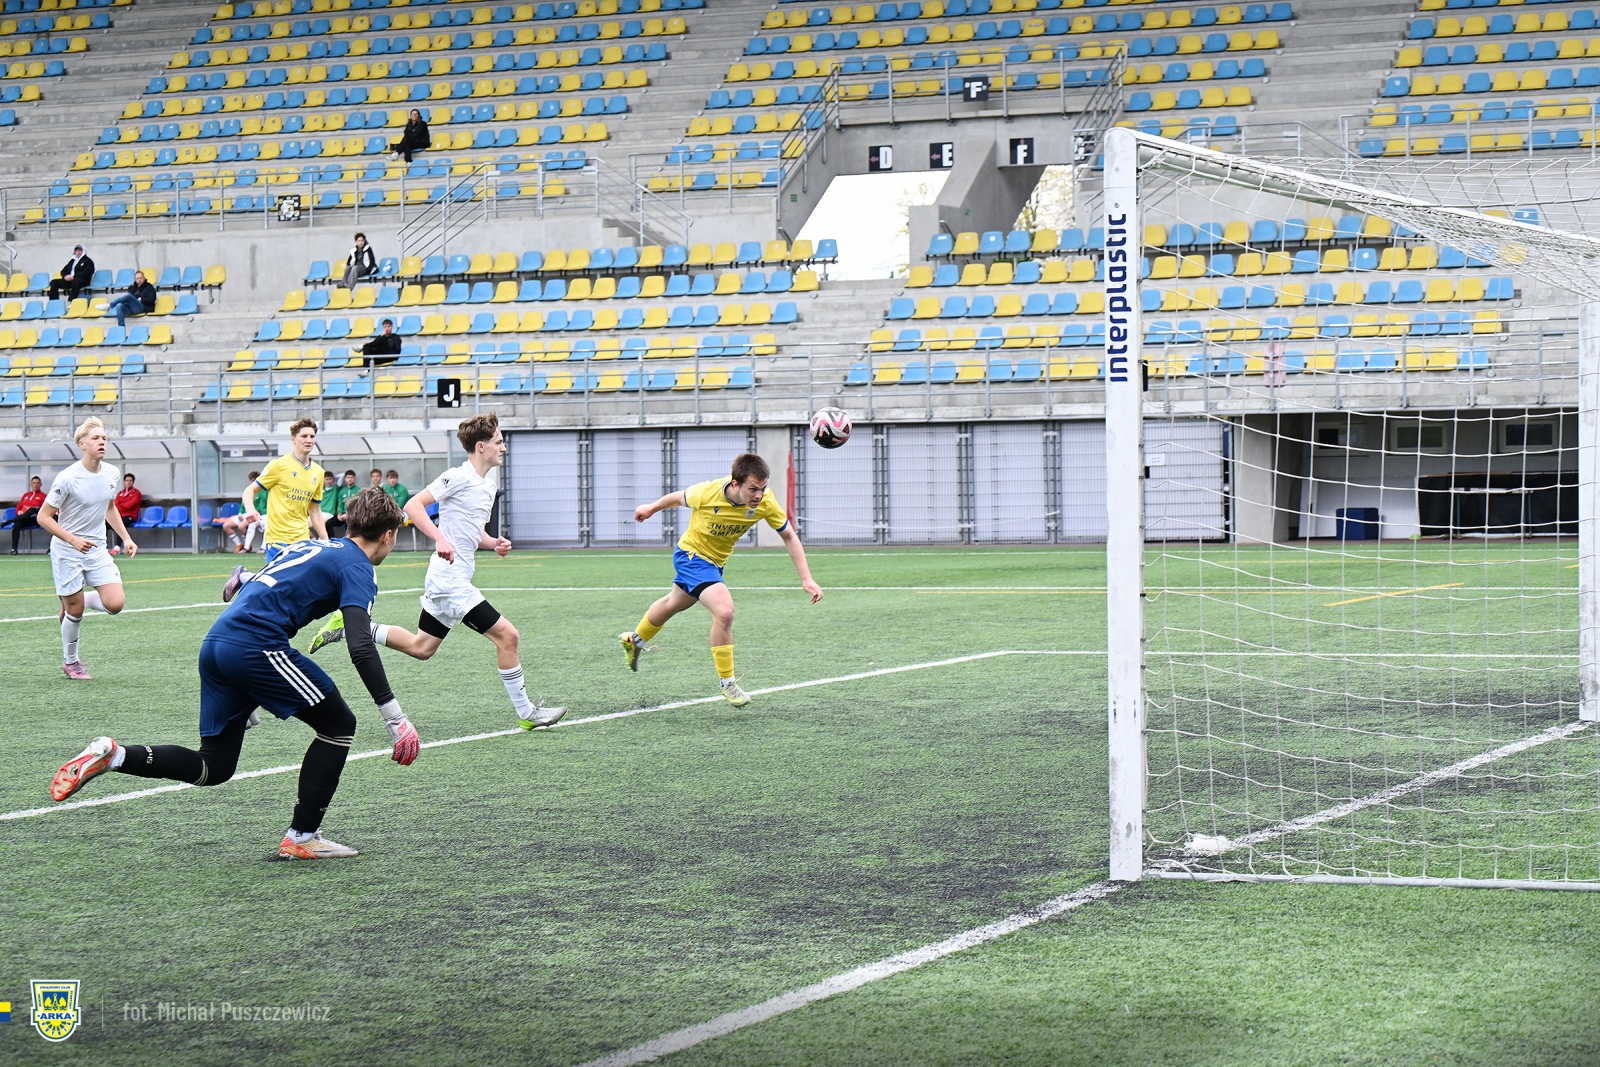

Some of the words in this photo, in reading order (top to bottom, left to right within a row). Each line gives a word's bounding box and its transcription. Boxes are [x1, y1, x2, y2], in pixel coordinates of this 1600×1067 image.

[970, 82, 983, 98] F
[879, 146, 892, 169] D
[941, 143, 953, 167] E
[1016, 144, 1028, 165] F
